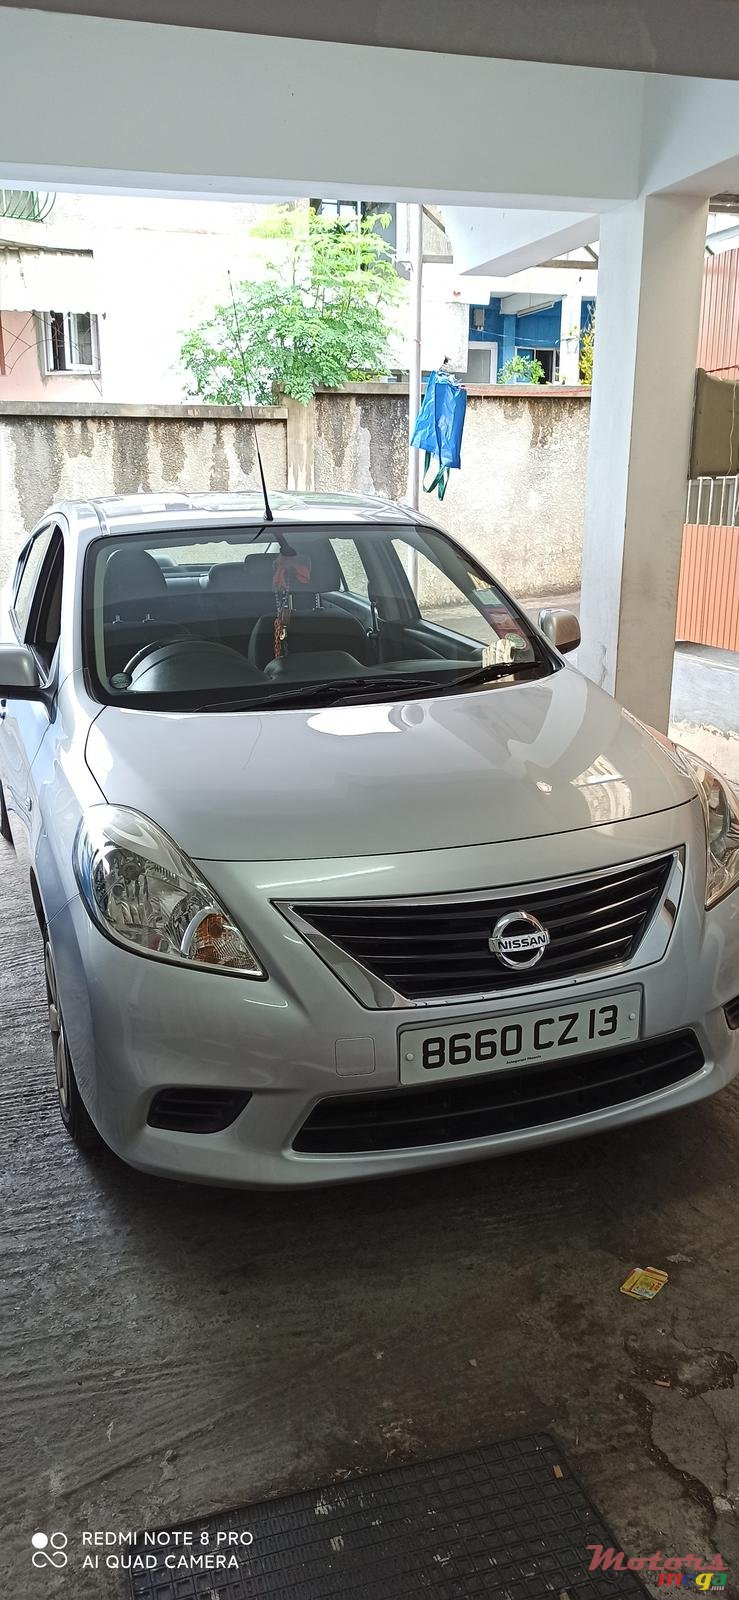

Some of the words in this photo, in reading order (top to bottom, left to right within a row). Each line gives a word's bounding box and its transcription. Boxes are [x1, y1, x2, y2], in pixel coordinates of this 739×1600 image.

[497, 934, 546, 950] NISSAN
[422, 1024, 522, 1069] 8660
[533, 1012, 579, 1050] CZ
[588, 1004, 618, 1039] 13
